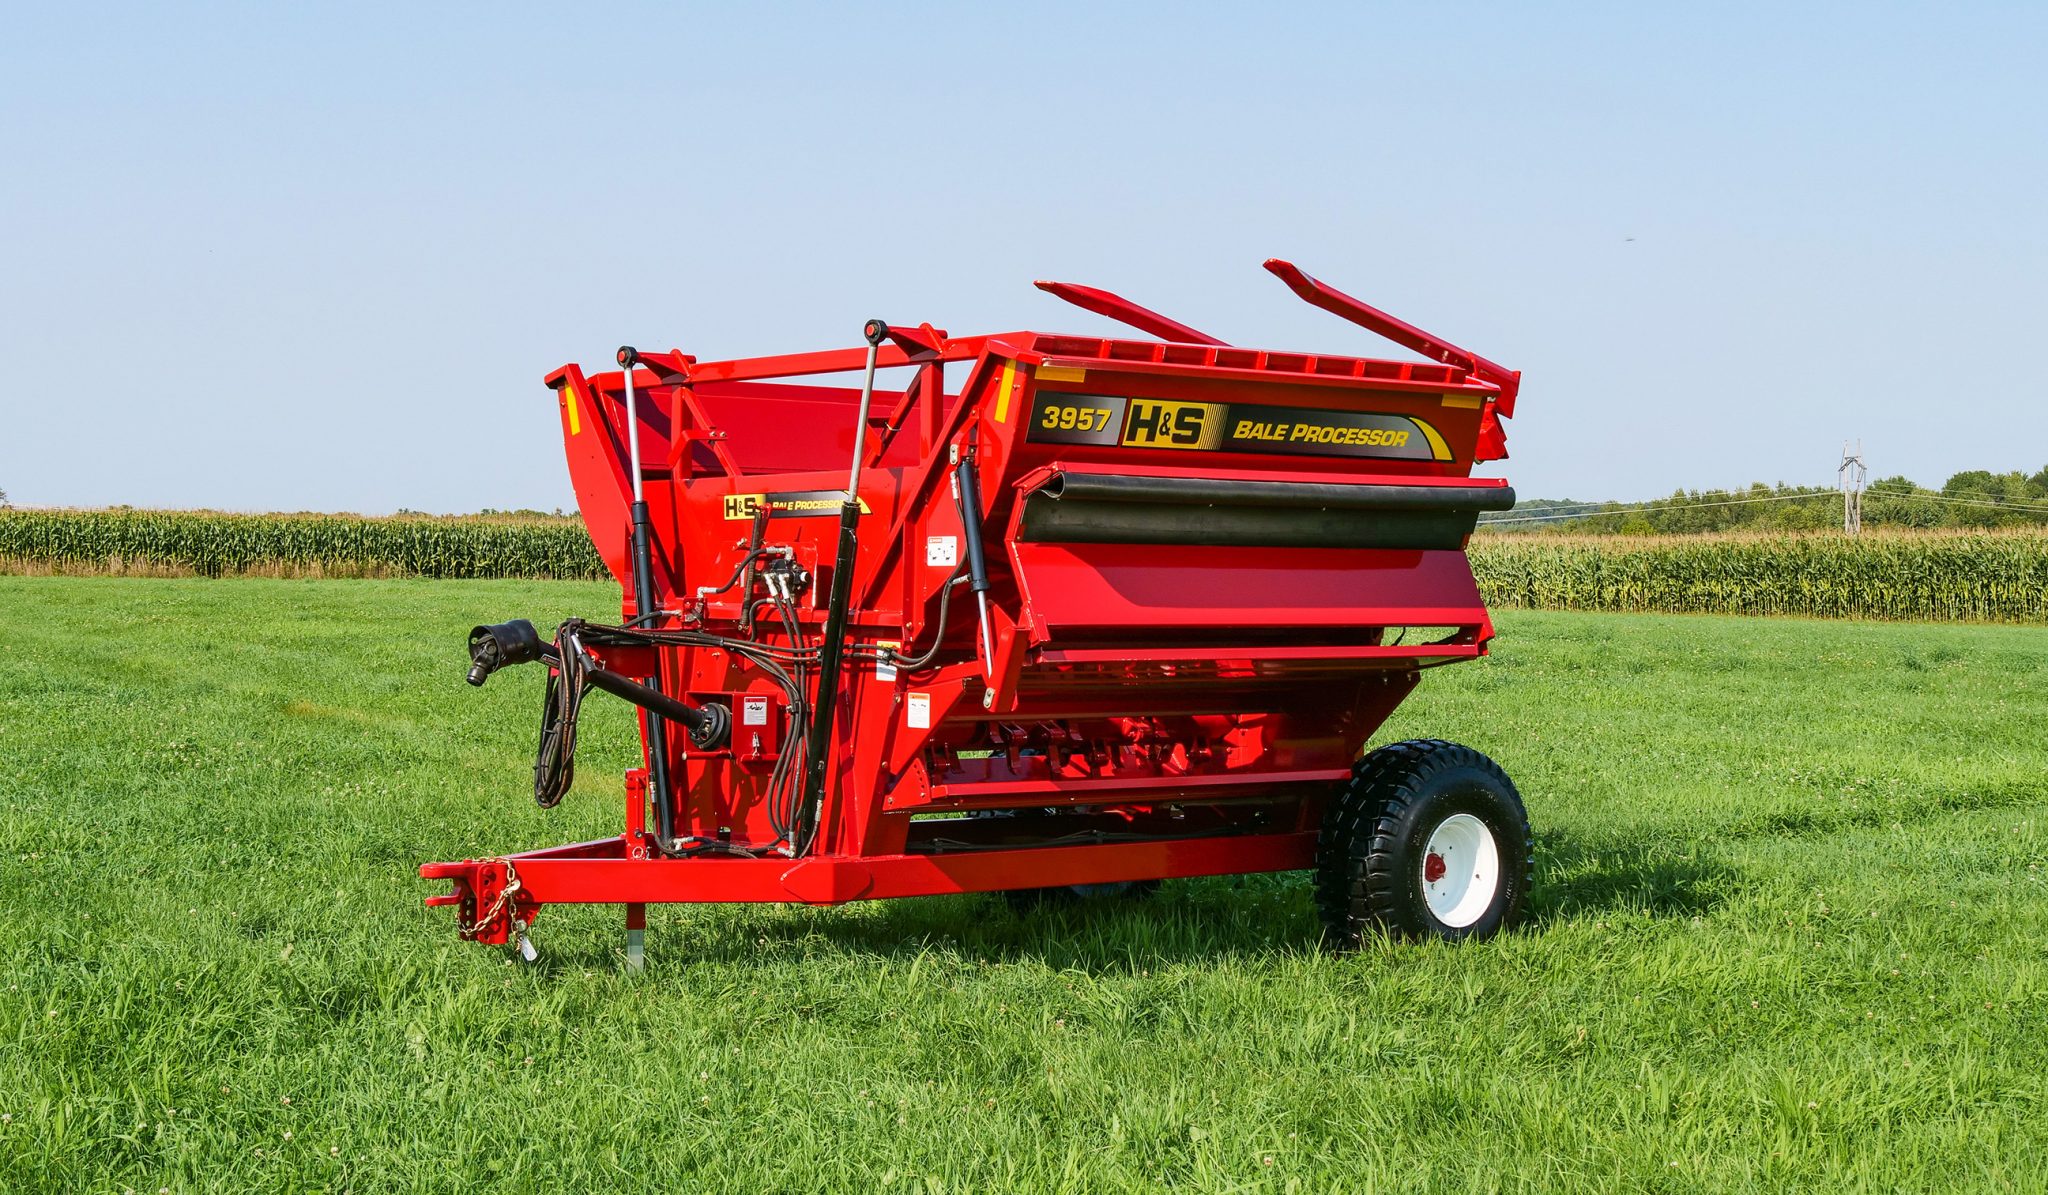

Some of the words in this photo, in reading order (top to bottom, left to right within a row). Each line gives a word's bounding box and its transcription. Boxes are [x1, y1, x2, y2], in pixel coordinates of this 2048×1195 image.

[1042, 406, 1112, 432] 3957
[1125, 404, 1205, 445] H&S
[1232, 420, 1289, 441] BALE
[1289, 423, 1409, 447] PROCESSOR
[725, 497, 756, 517] H&S
